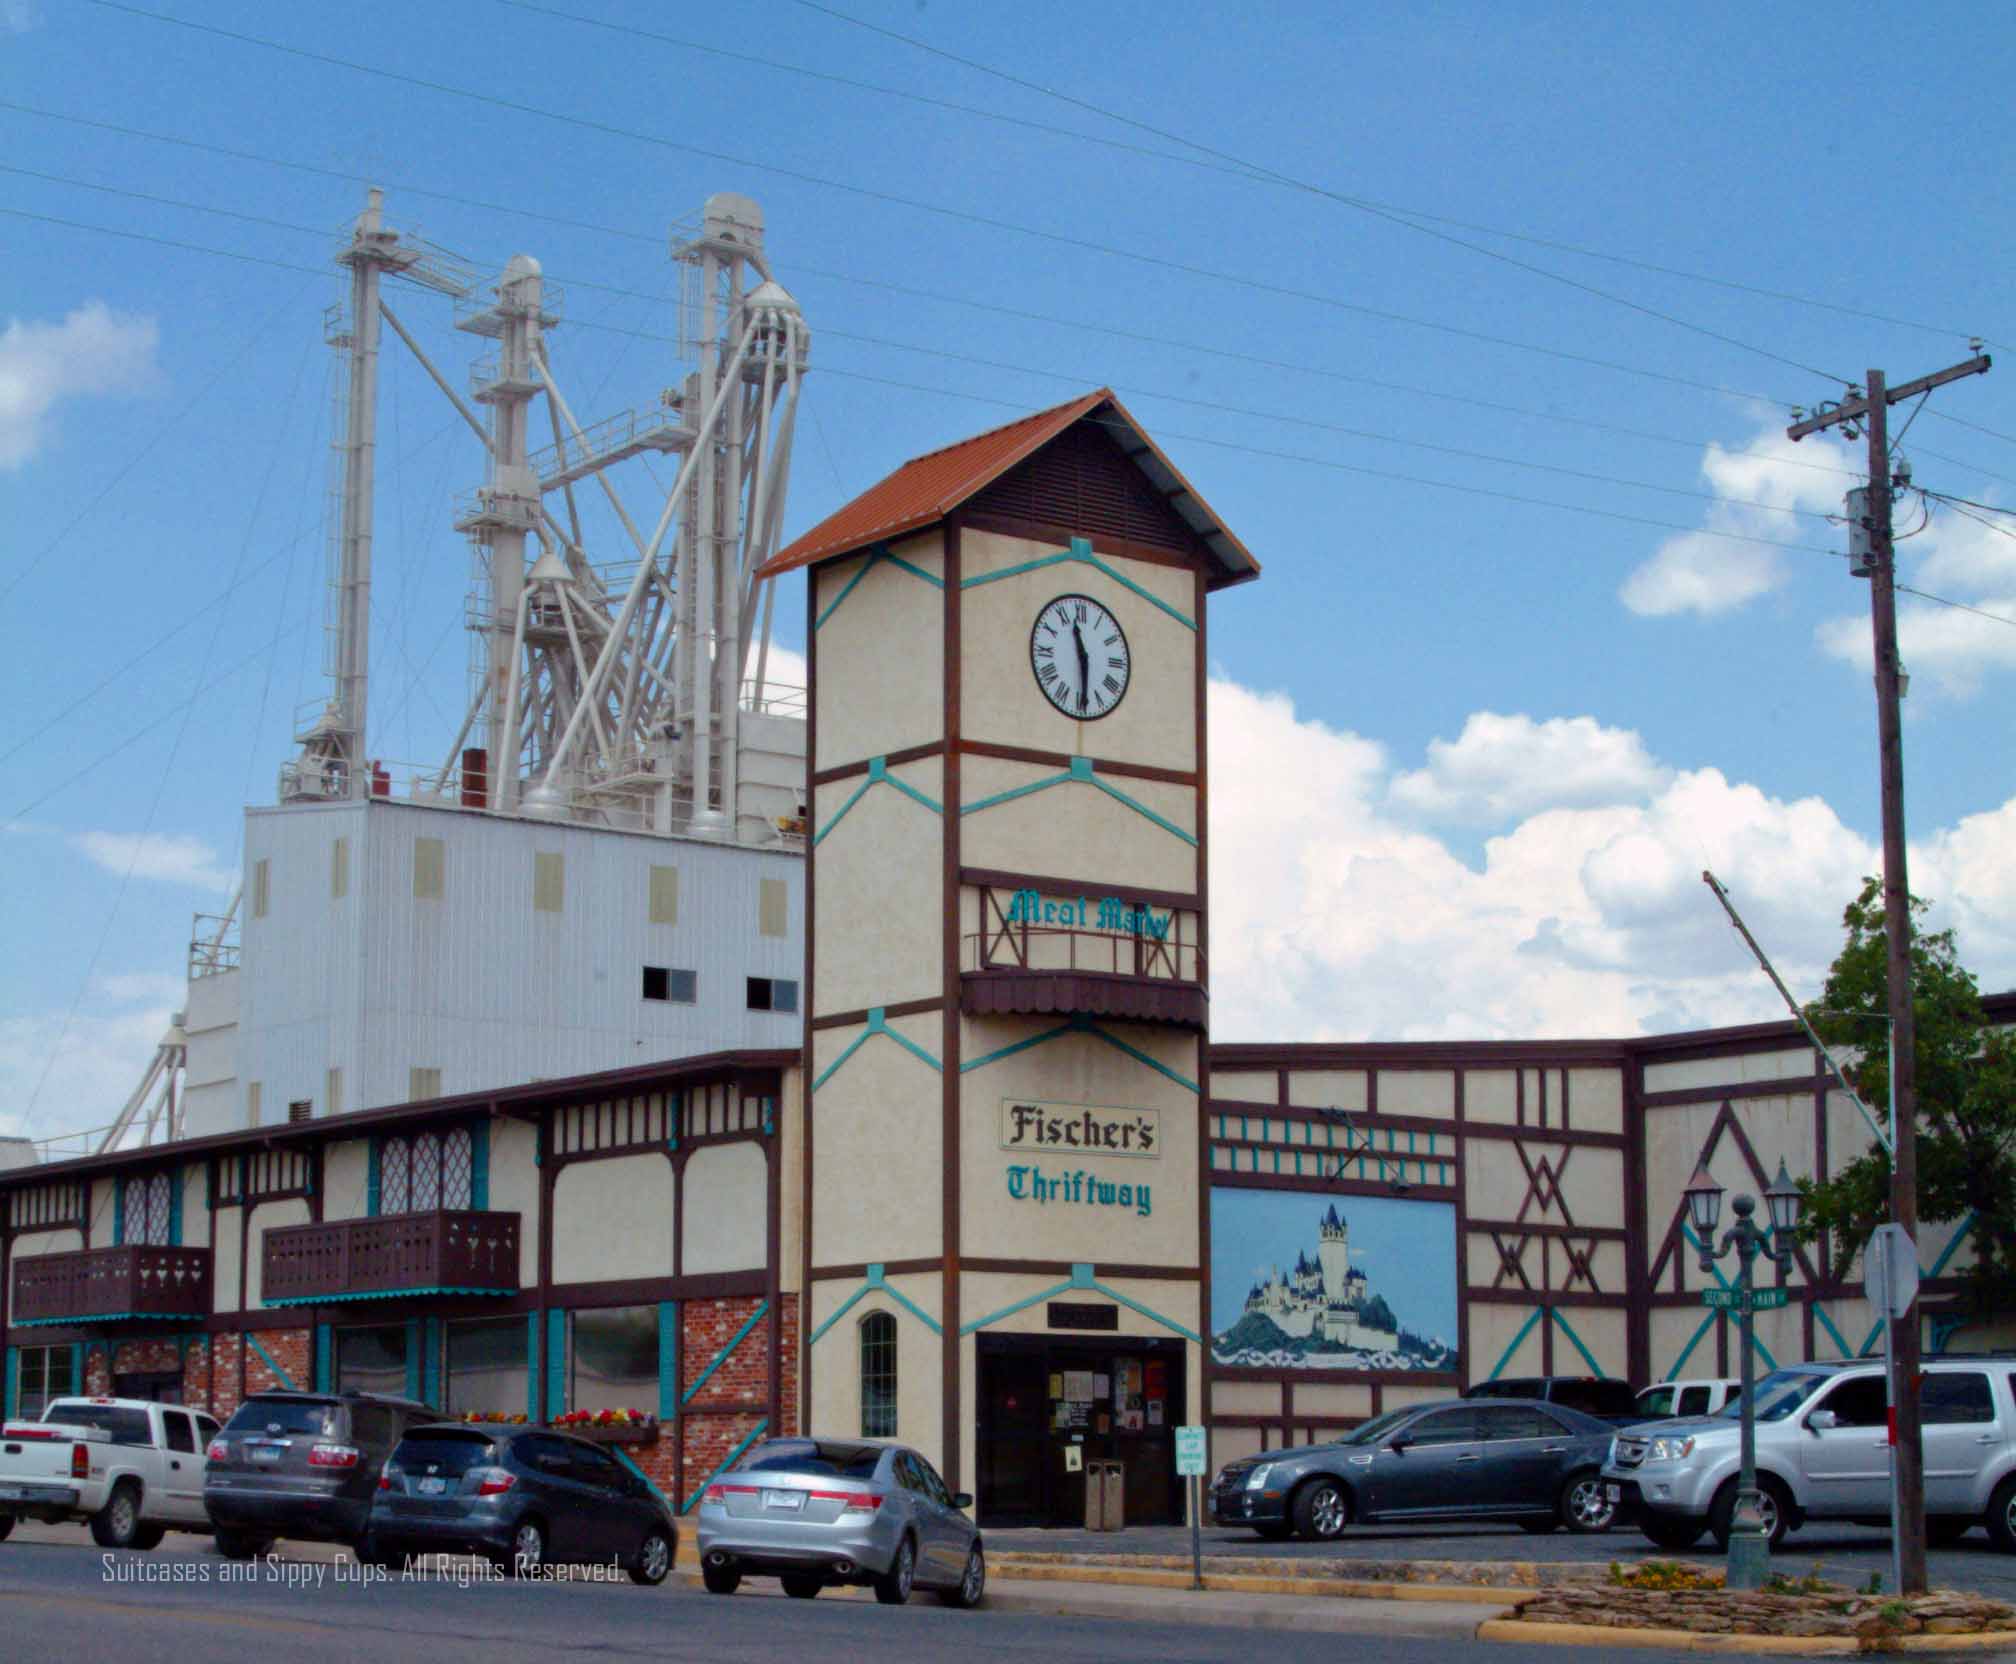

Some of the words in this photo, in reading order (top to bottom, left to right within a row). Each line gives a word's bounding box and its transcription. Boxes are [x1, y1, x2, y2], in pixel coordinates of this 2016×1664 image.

[1006, 888, 1086, 928] Meat
[1096, 897, 1168, 941] Market
[1010, 1105, 1154, 1150] Fischer's
[1007, 1165, 1152, 1216] Thriftway
